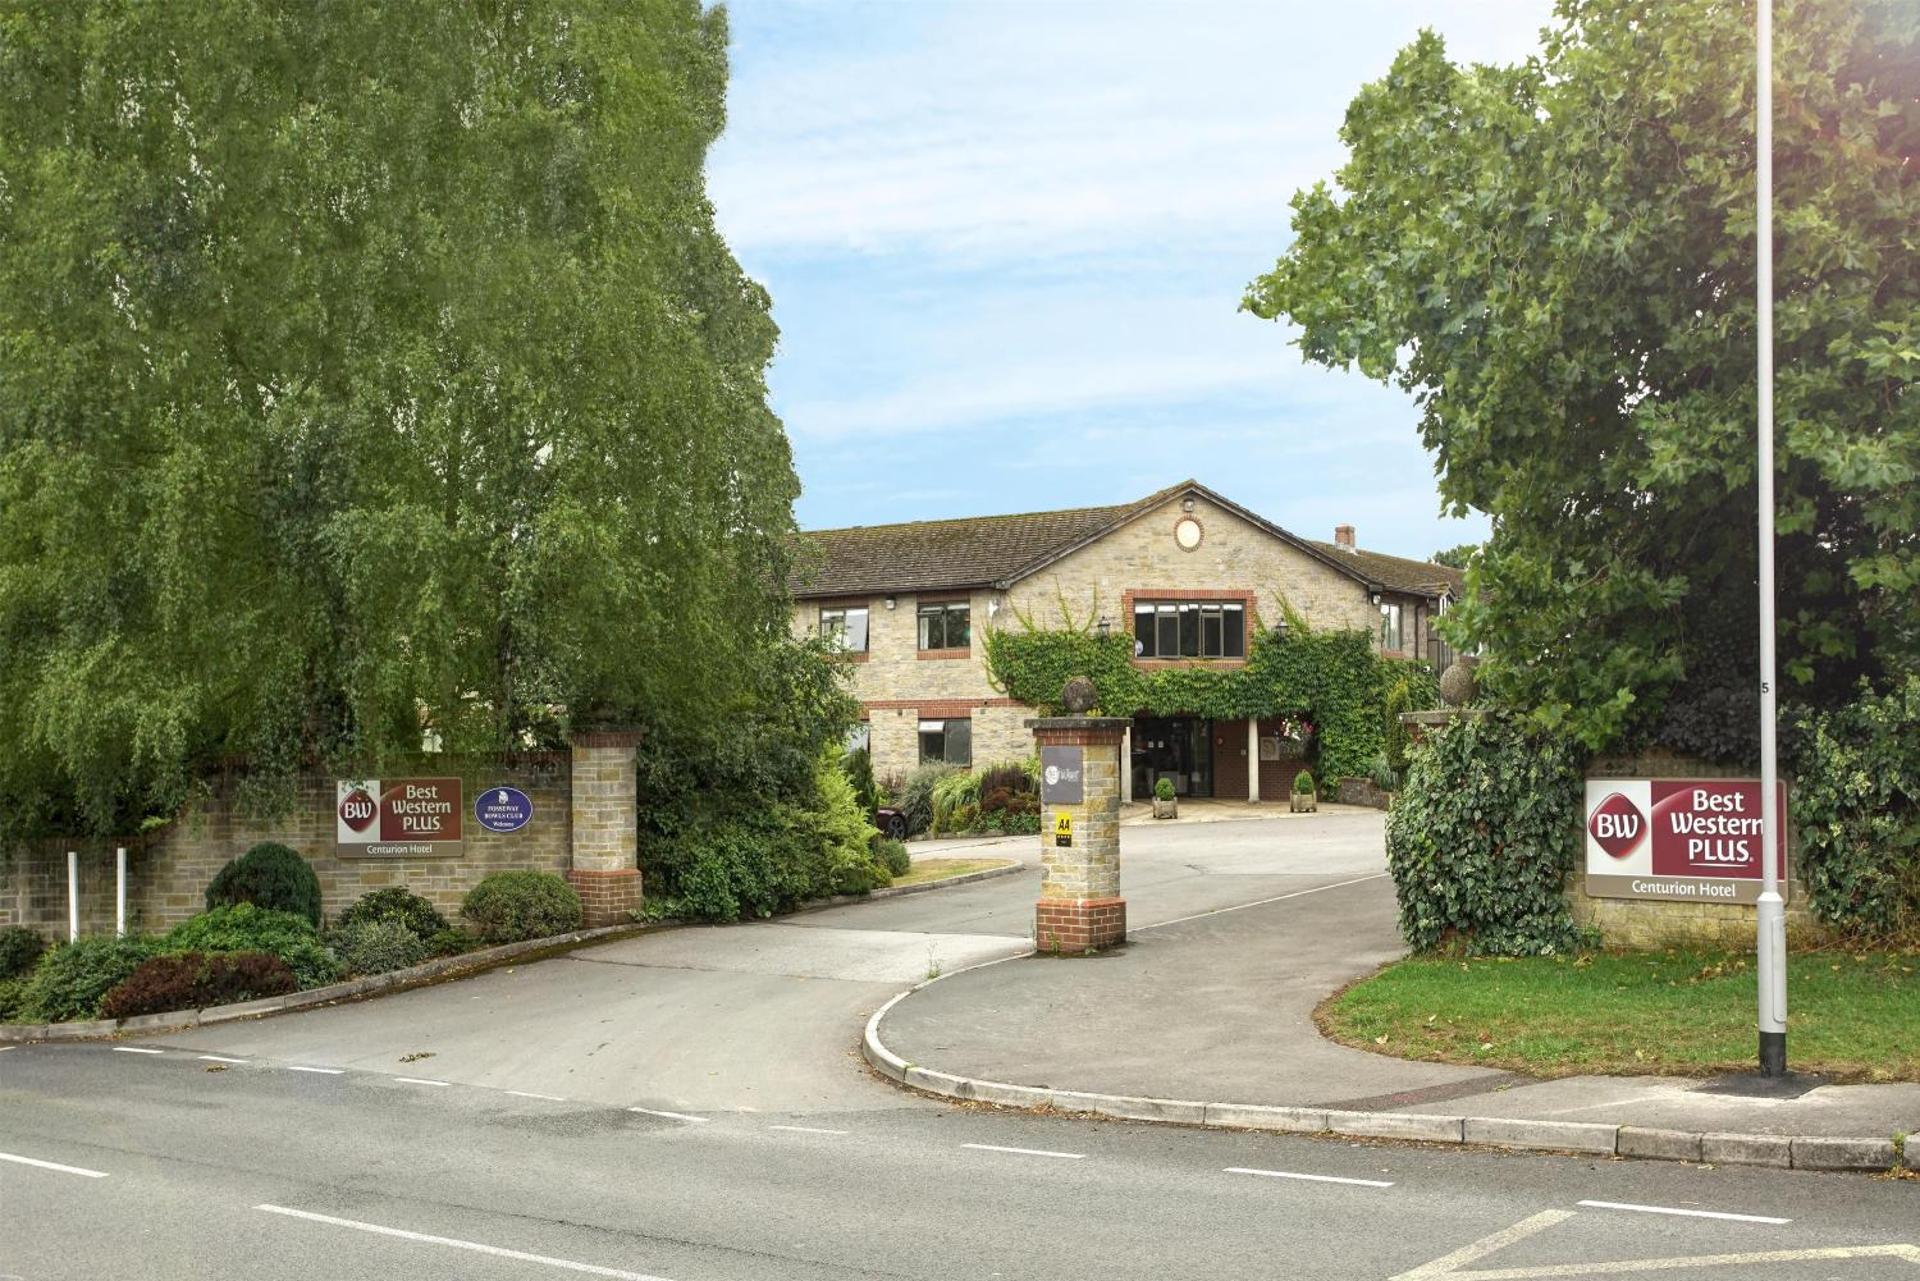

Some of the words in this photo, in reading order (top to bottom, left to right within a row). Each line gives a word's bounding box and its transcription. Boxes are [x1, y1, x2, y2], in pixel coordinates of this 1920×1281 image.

[1762, 682, 1769, 693] 5
[406, 785, 438, 800] Best
[1693, 790, 1744, 811] Best
[344, 801, 372, 819] BW
[392, 799, 451, 815] Western
[1058, 819, 1070, 831] AA
[1597, 813, 1638, 839] BW
[1670, 812, 1764, 835] Western
[366, 844, 408, 855] Centurion
[409, 844, 433, 854] Hotel
[1632, 880, 1695, 896] Centurion
[1699, 882, 1736, 897] Hotel
